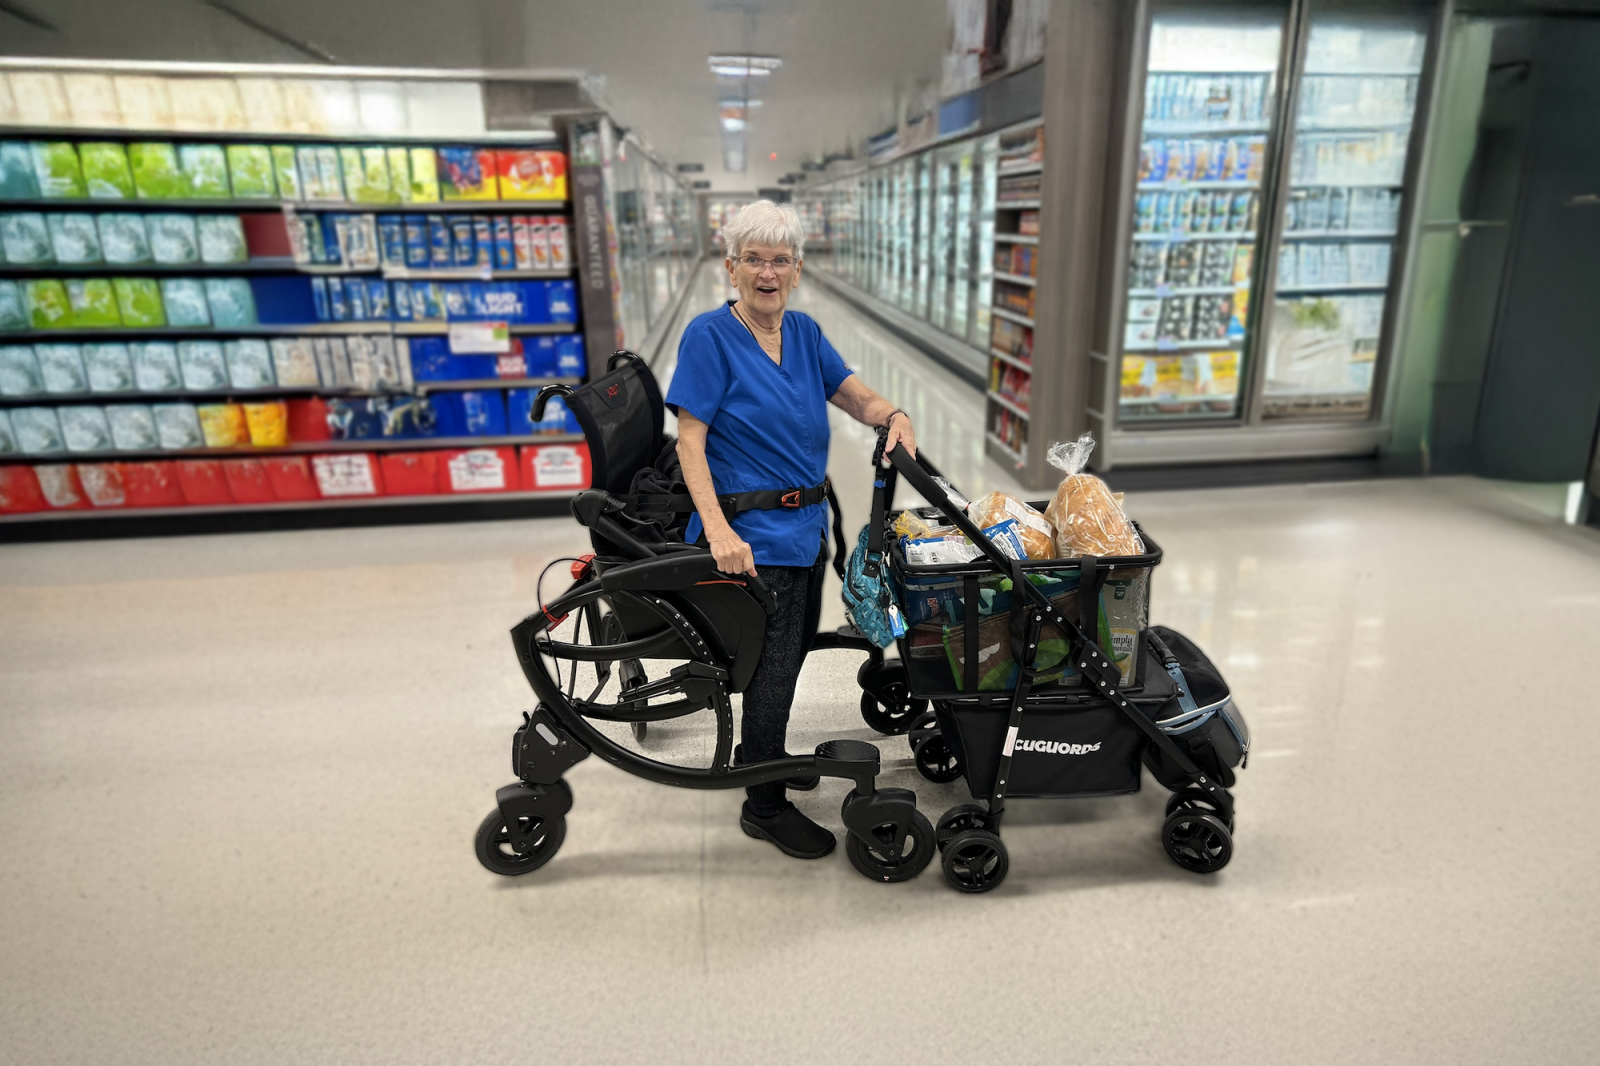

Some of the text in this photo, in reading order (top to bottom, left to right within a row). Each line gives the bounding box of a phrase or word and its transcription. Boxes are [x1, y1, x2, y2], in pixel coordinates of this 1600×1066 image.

[485, 291, 517, 303] BUD
[482, 302, 523, 315] LIGHT
[1110, 633, 1133, 647] imply
